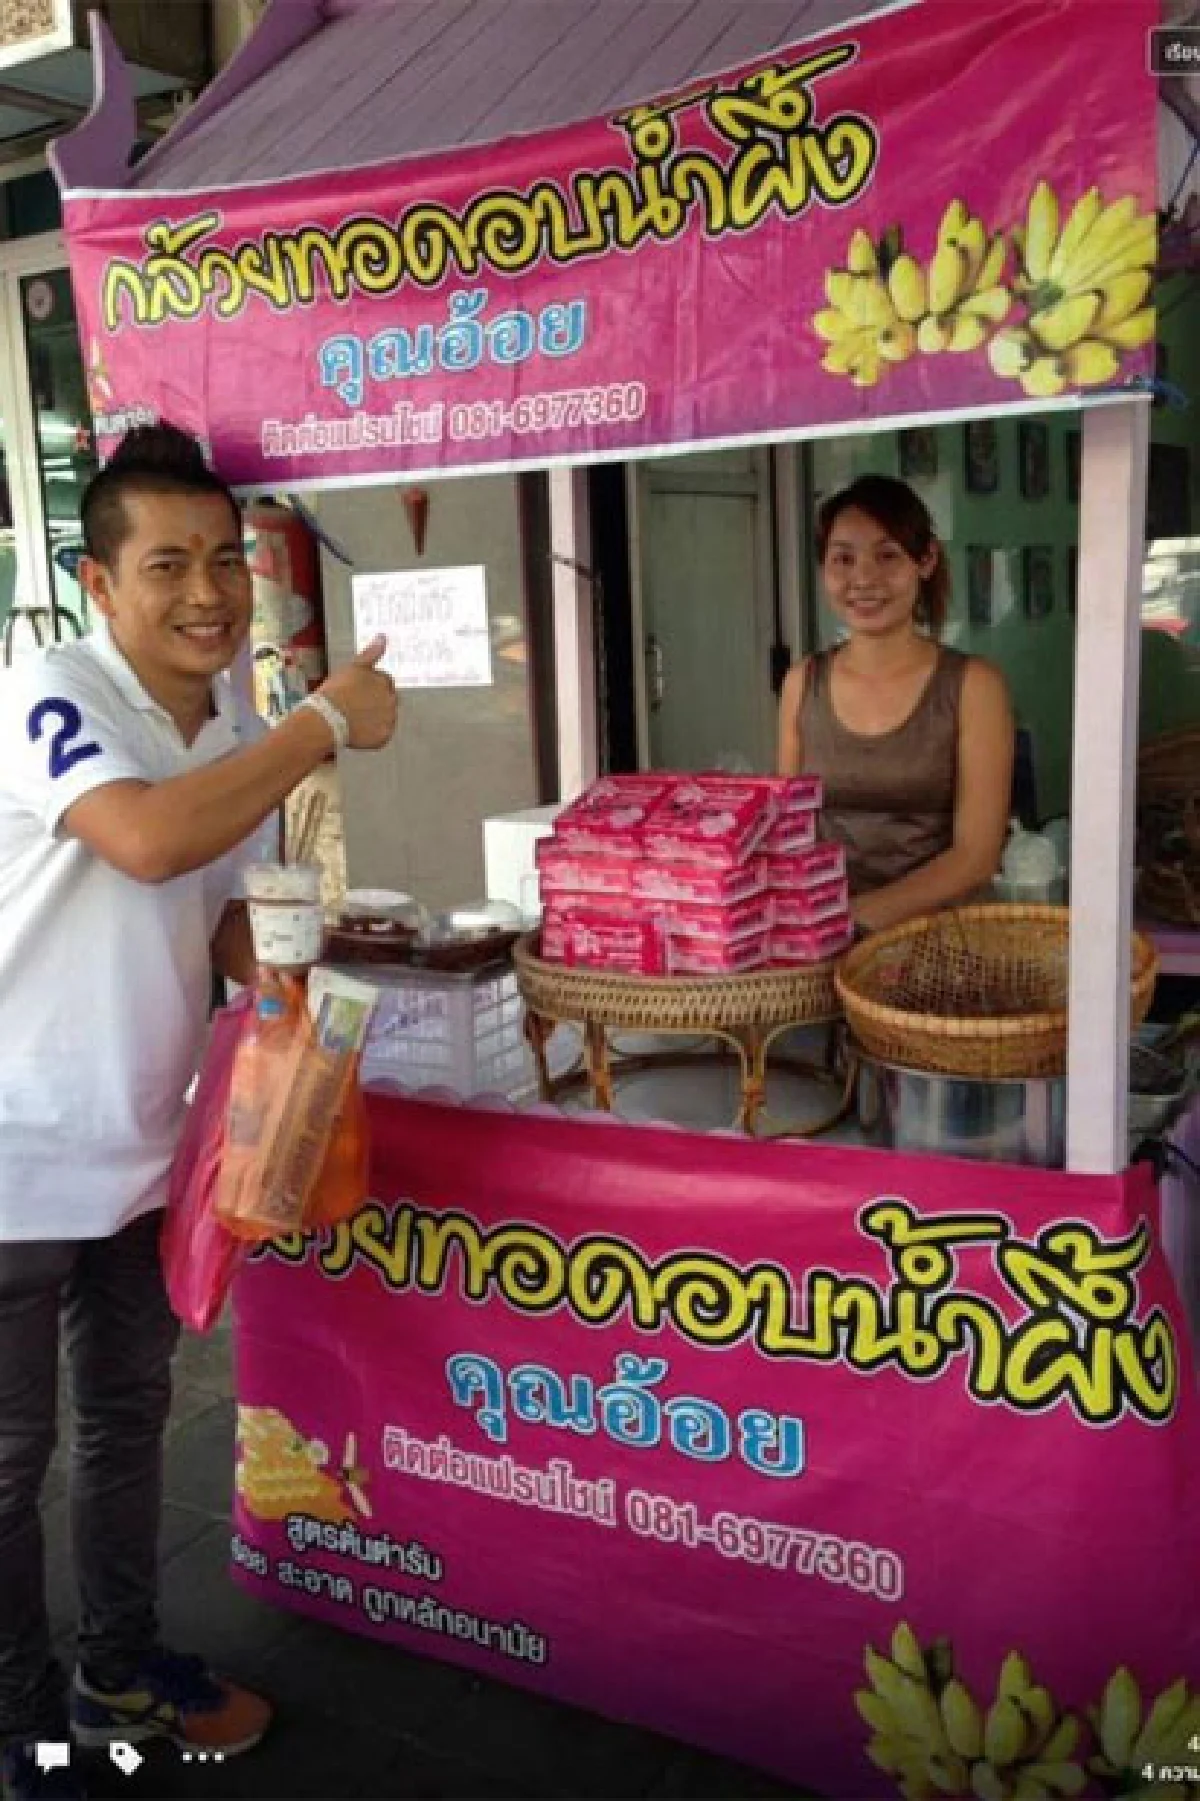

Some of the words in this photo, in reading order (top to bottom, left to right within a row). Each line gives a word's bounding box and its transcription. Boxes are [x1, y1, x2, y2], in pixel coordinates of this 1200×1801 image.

[103, 42, 879, 330] กล้วยทอดอบน้ำผึ้ง
[317, 289, 589, 408] คุณอ้อย
[449, 381, 647, 441] 081-6977360
[27, 696, 103, 779] 2
[445, 1352, 806, 1479] คุณอ้อย
[625, 1488, 905, 1603] 081-6977360
[277, 1561, 354, 1604] สะอาด
[362, 1586, 547, 1664] ถูกหลักอนามัย
